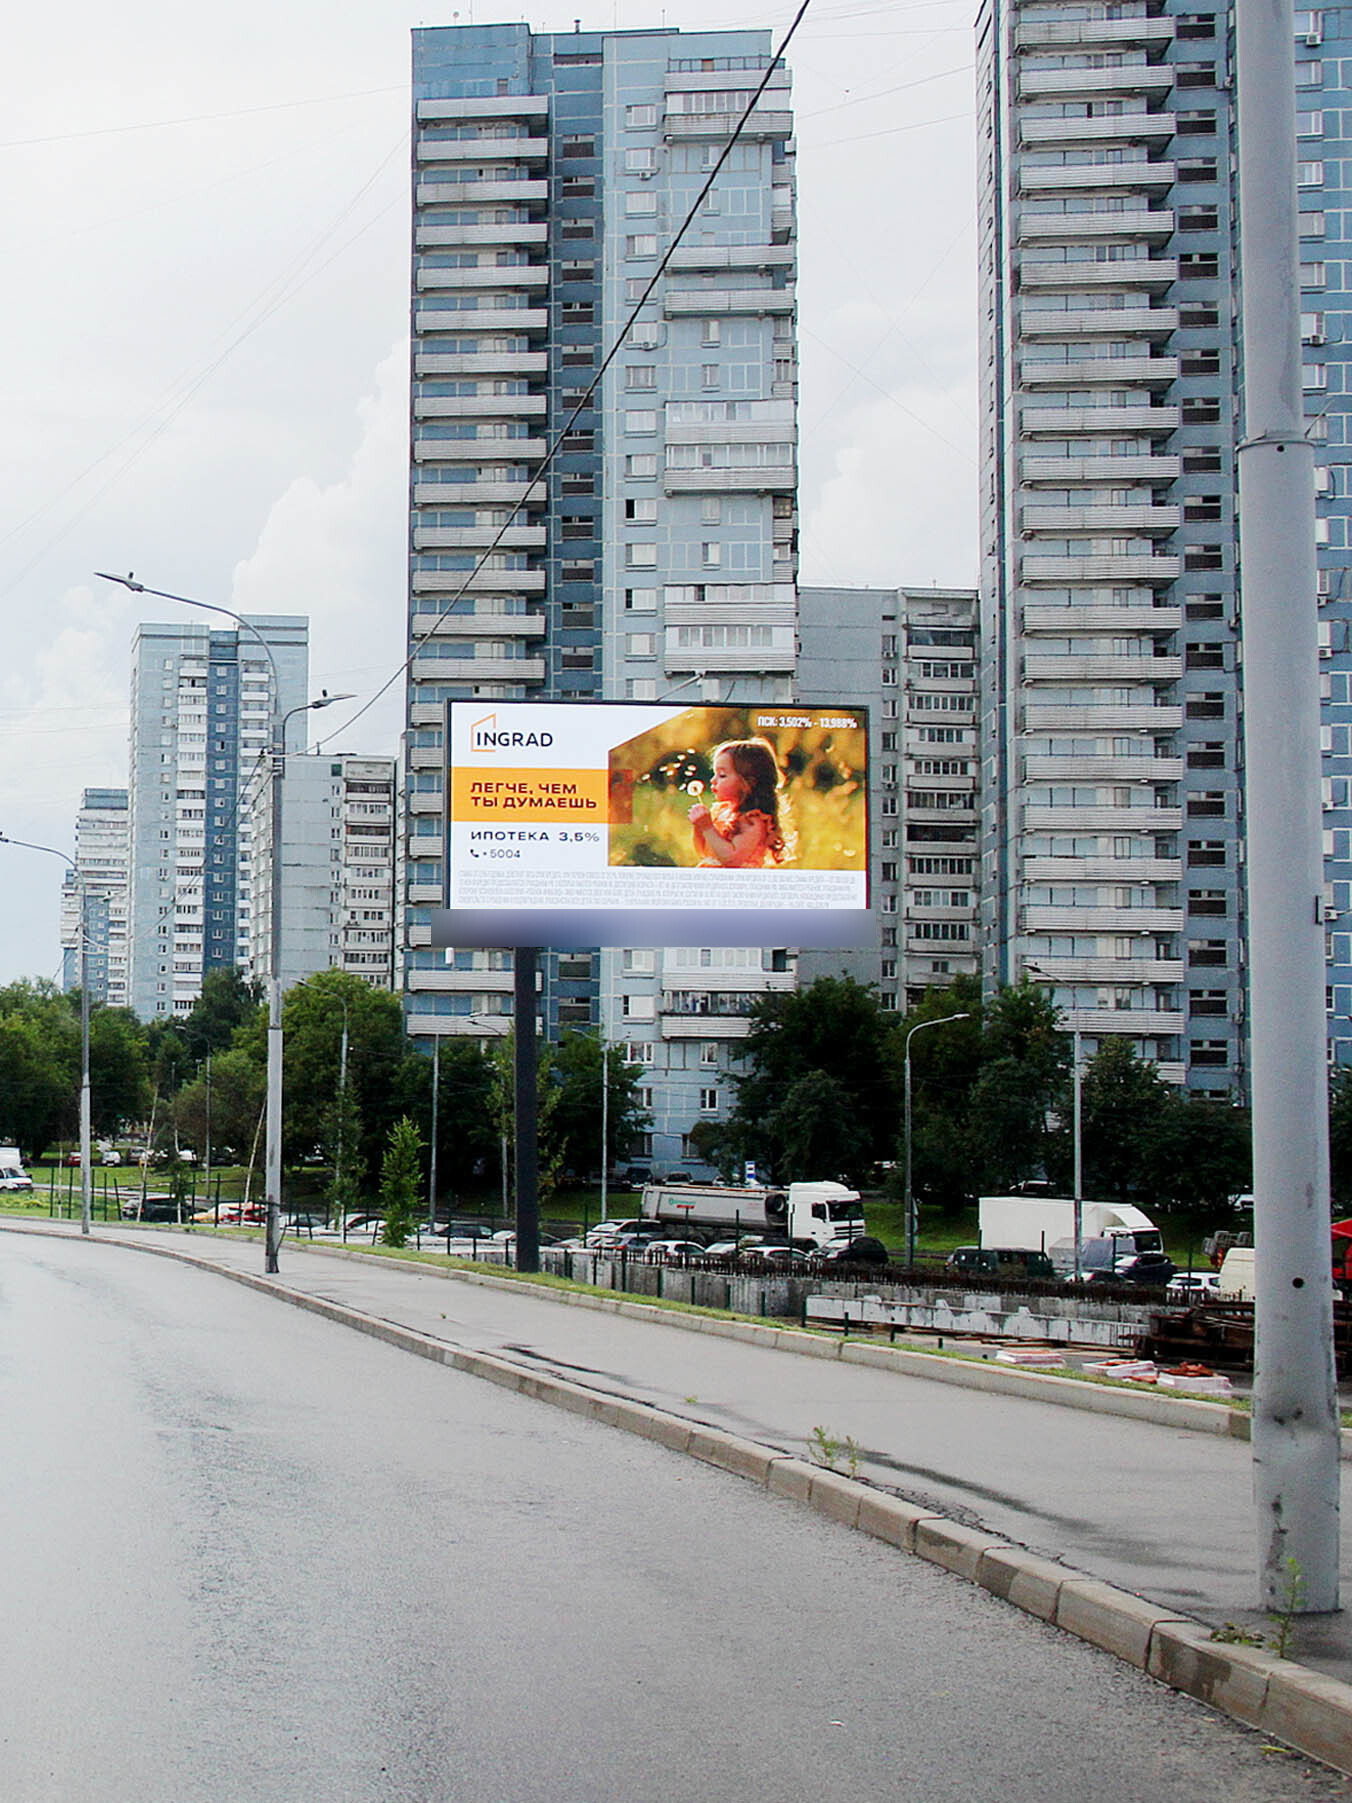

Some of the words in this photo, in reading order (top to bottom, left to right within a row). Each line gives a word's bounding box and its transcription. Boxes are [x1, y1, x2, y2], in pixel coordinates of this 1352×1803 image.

[476, 731, 554, 748] INGRAD
[470, 782, 534, 795] ЛЕГЧЕ,
[538, 783, 577, 795] ЧЕМ
[471, 796, 498, 807] ТЫ
[502, 796, 597, 809] ДУМАЕШЬ
[470, 831, 550, 841] ИПОТЕКА
[558, 831, 600, 843] 3,5%
